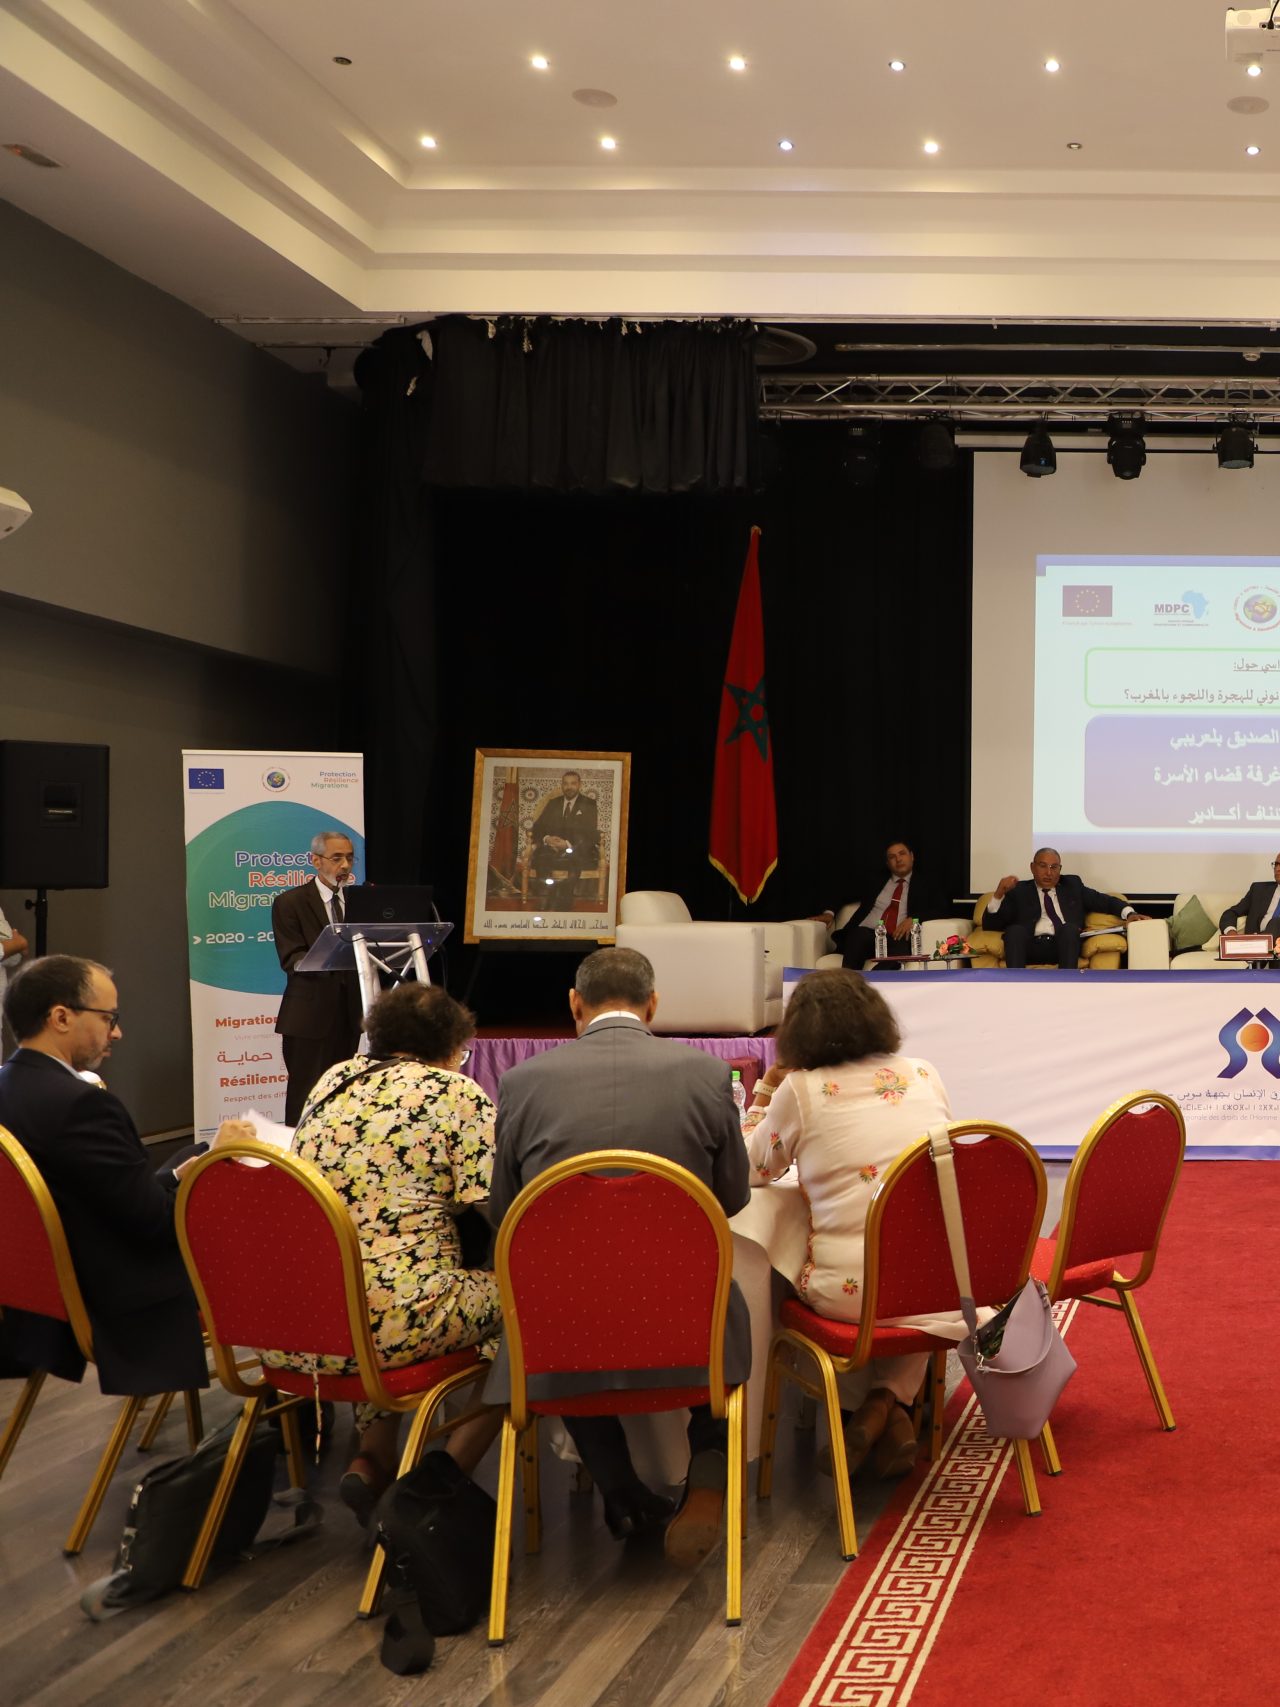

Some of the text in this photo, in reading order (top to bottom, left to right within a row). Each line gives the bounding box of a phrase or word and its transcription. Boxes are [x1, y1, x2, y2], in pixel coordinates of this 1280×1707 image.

[1154, 604, 1190, 614] MDPC
[1217, 689, 1254, 704] للهجرة
[1226, 728, 1280, 749] الصديق
[1204, 766, 1243, 784] قضاء
[235, 850, 314, 868] Protect
[205, 932, 245, 944] 2020
[257, 931, 275, 942] 20
[217, 1050, 273, 1065] حماية
[219, 1073, 290, 1088] Résilienc
[223, 1094, 256, 1103] Respect
[257, 1092, 272, 1100] des
